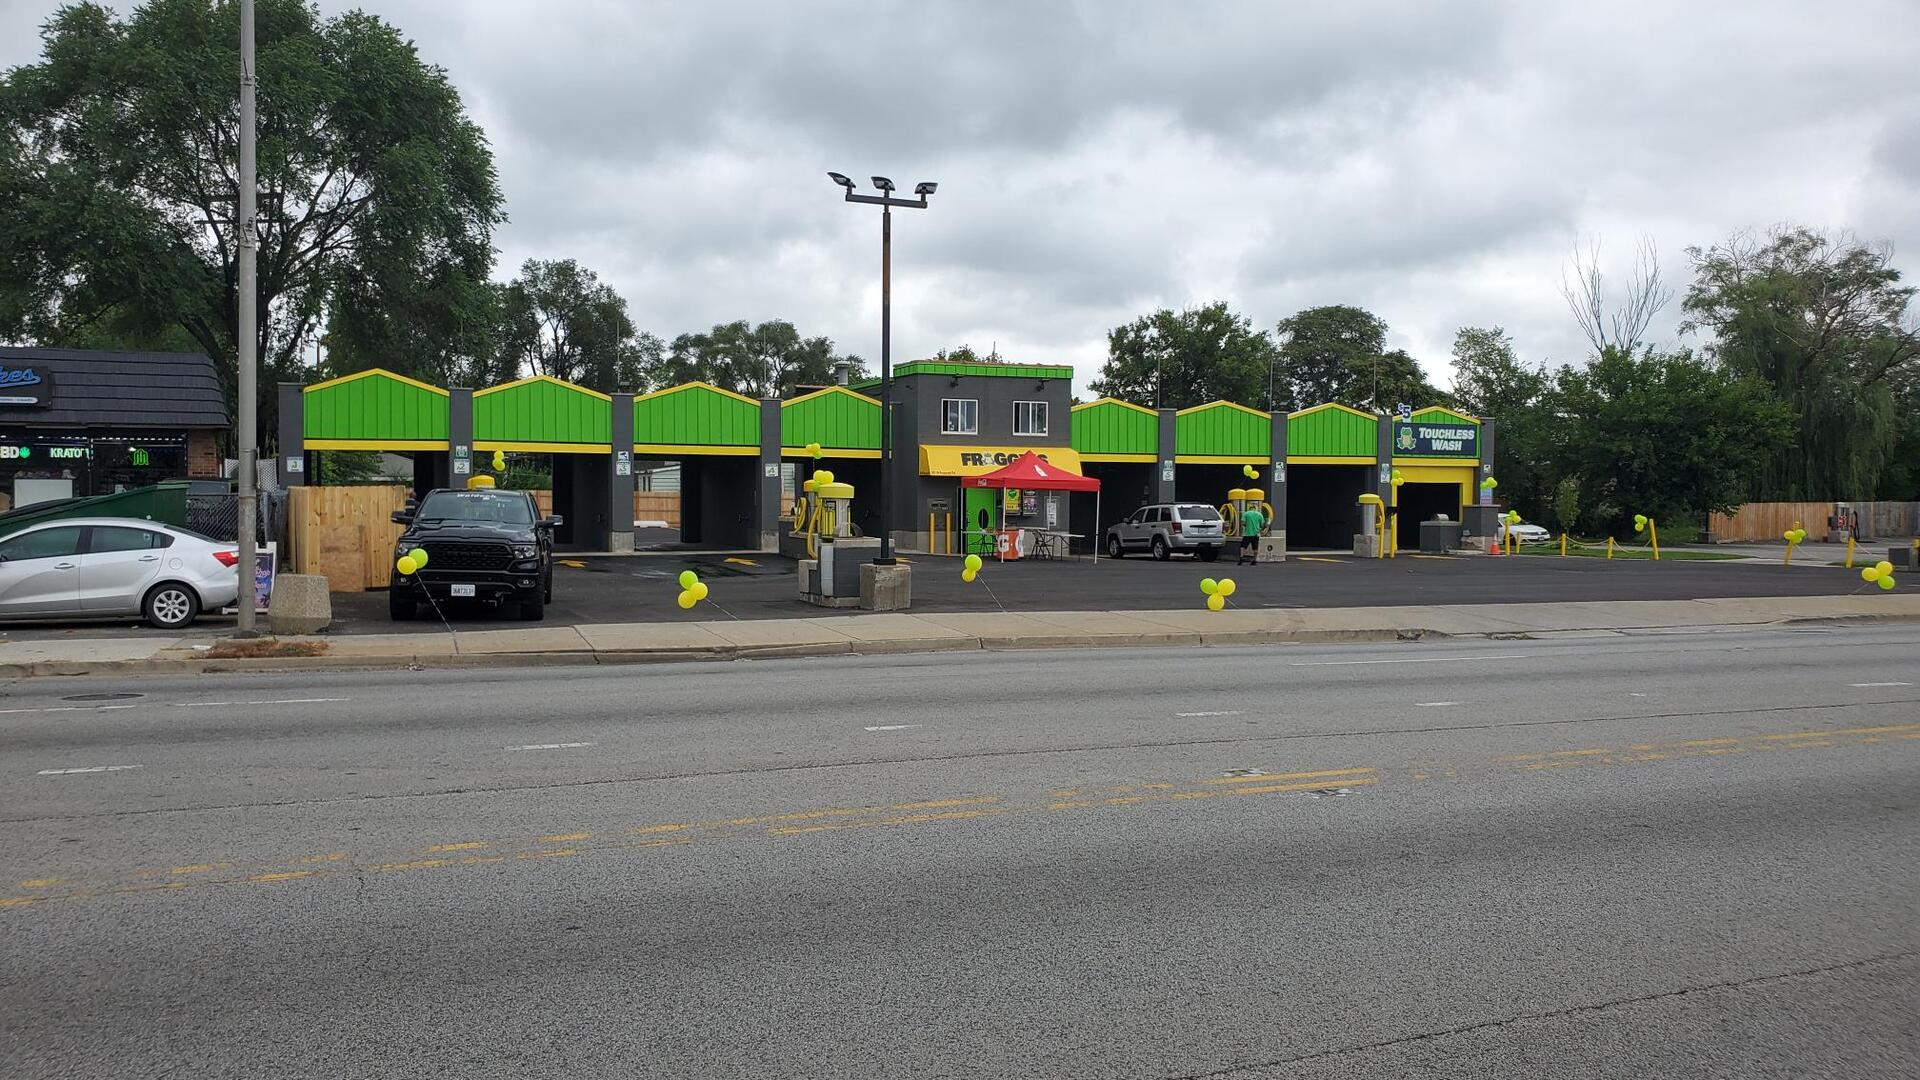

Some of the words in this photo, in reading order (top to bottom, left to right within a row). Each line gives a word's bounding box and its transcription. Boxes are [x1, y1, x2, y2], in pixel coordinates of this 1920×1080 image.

[1419, 427, 1474, 440] TOUCHLESS
[1431, 439, 1462, 451] WASH
[0, 446, 20, 459] BD
